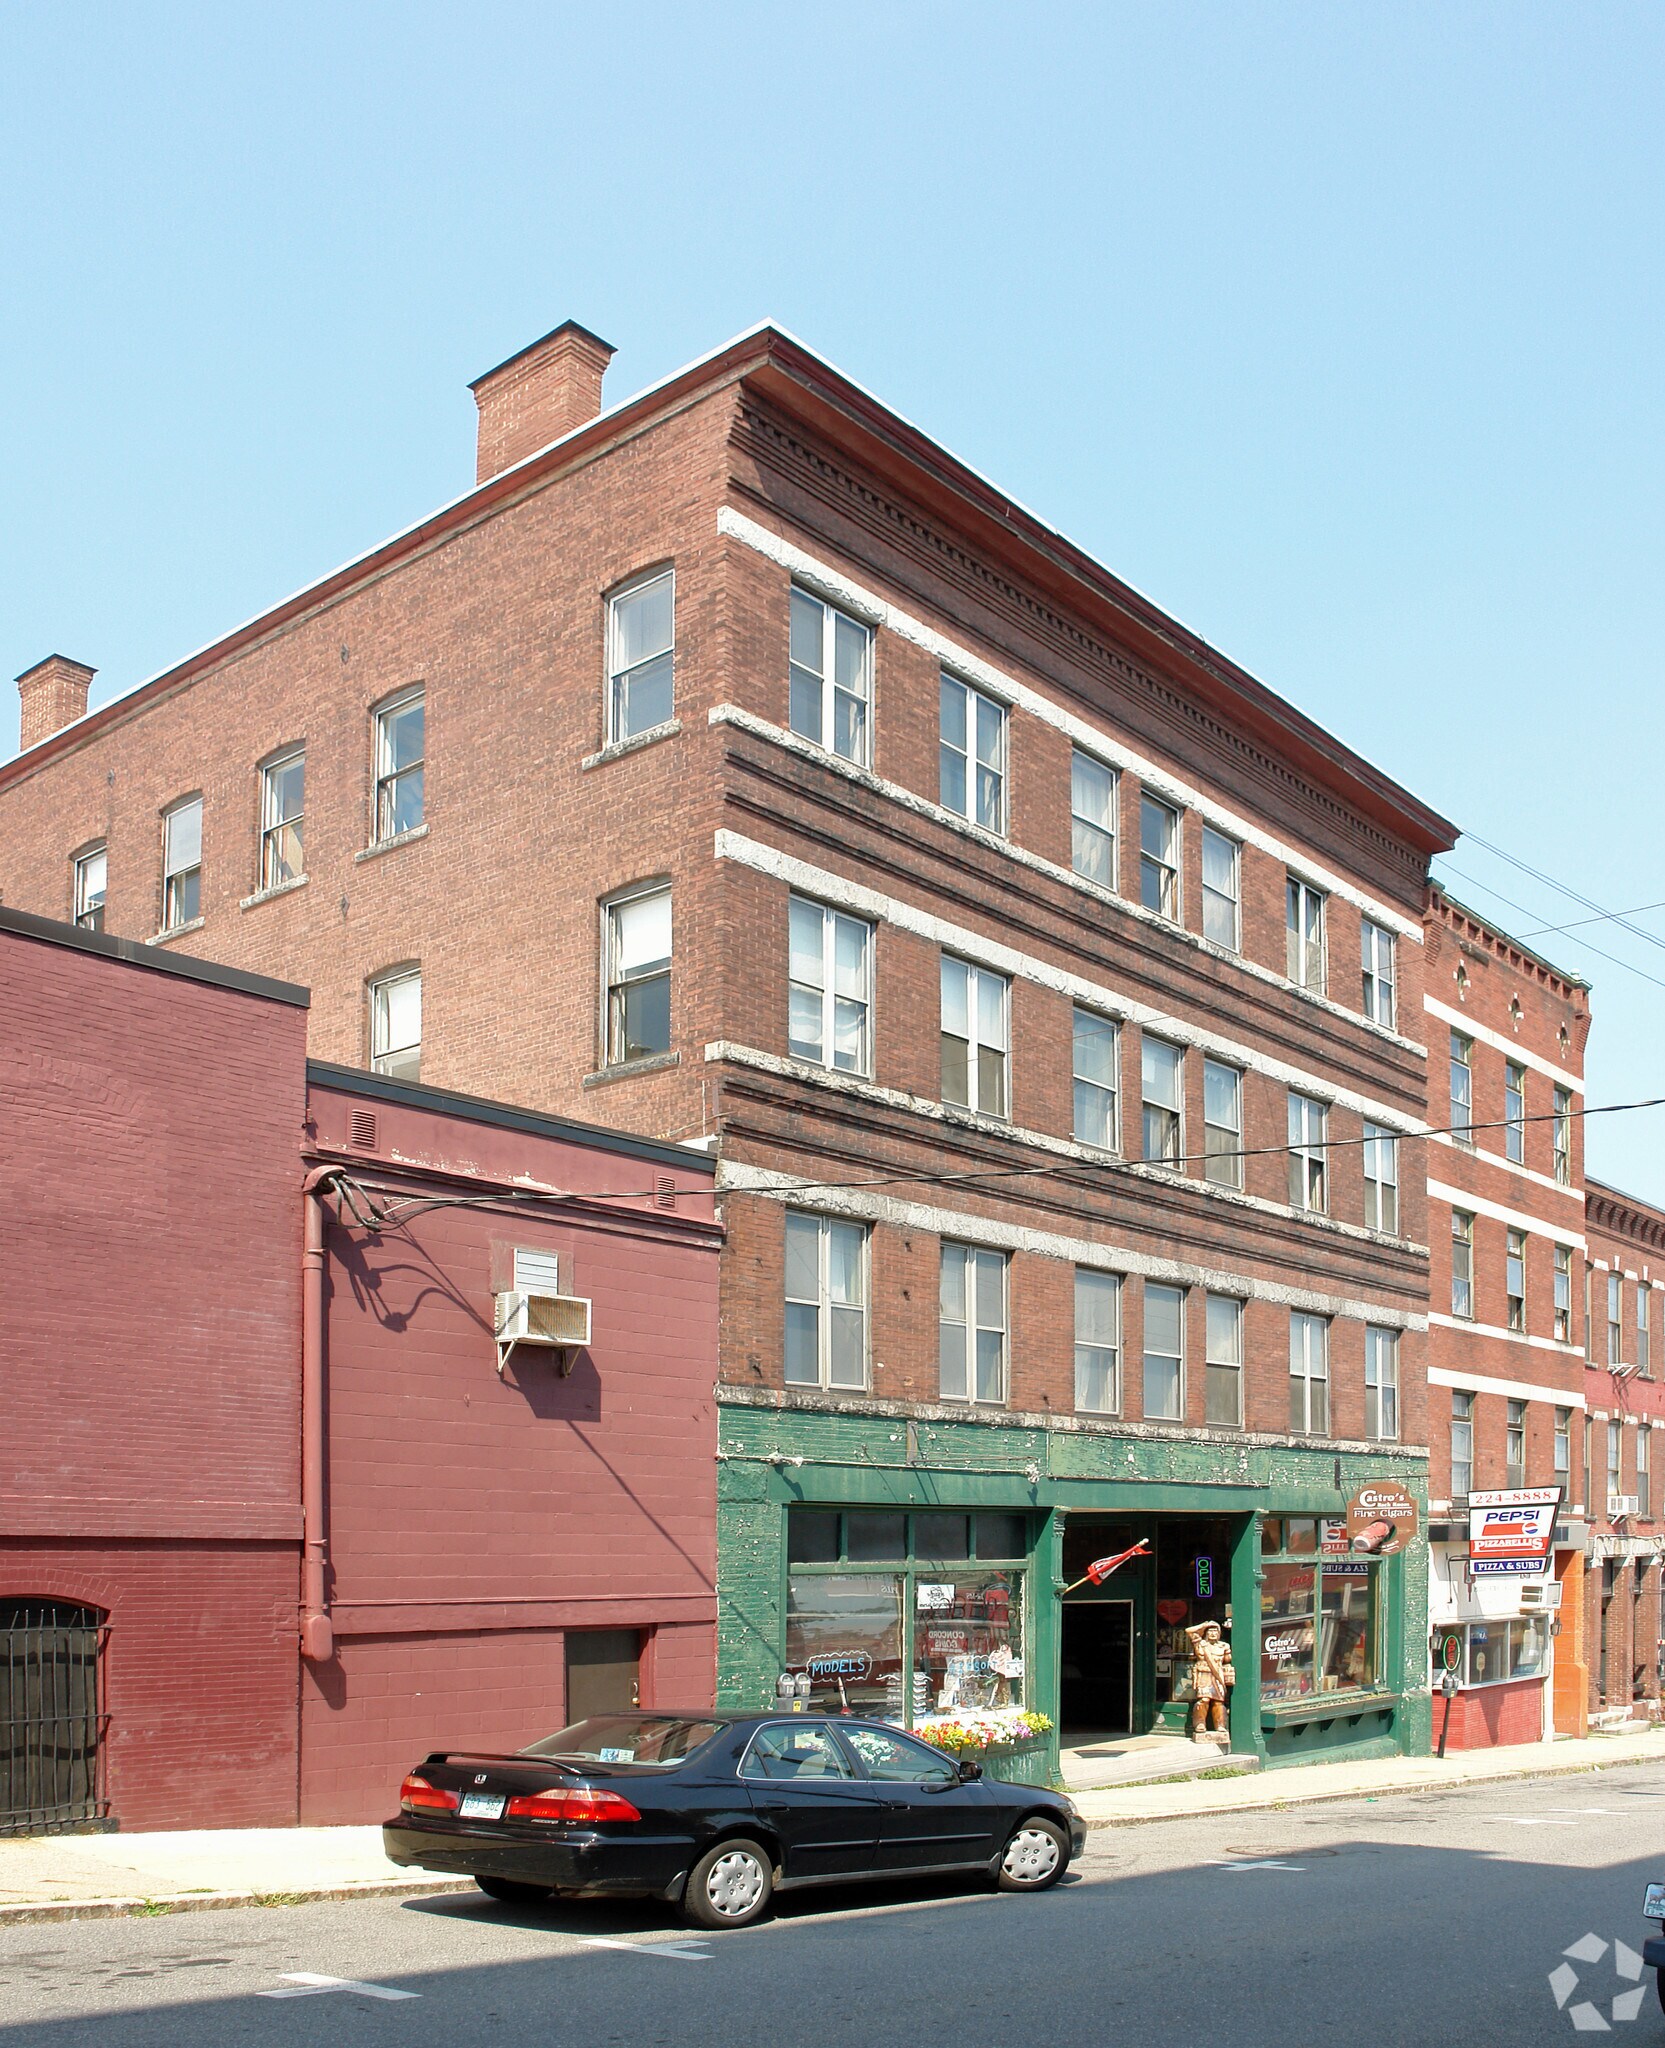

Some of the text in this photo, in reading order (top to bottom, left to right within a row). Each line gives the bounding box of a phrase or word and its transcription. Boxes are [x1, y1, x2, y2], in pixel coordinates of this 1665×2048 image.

[1360, 1490, 1405, 1507] Castro's
[1475, 1490, 1552, 1504] 224-8888
[1354, 1509, 1413, 1519] Fine Cigars
[1485, 1510, 1540, 1522] PEPSI
[1478, 1561, 1540, 1571] PIZZA & SUBS
[1198, 1559, 1210, 1595] OPEN
[1265, 1636, 1295, 1652] Castro's
[812, 1658, 865, 1677] MODELS
